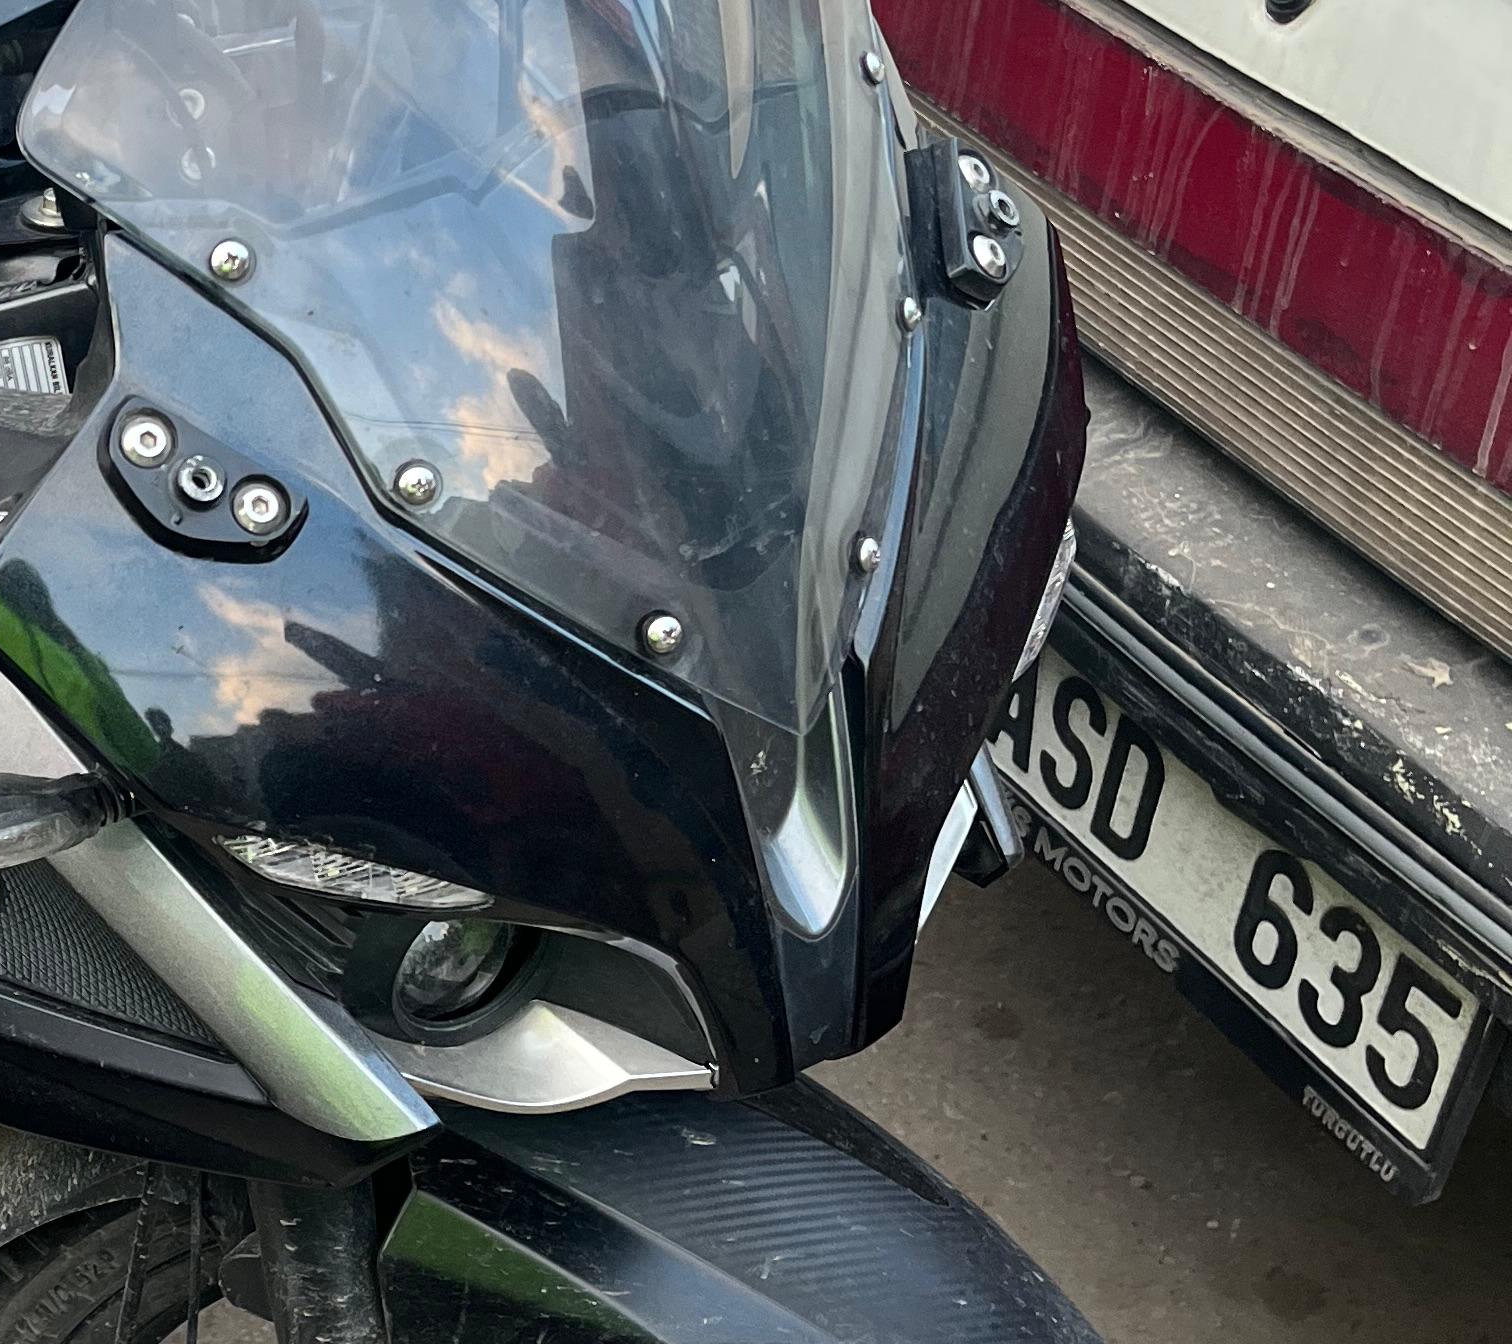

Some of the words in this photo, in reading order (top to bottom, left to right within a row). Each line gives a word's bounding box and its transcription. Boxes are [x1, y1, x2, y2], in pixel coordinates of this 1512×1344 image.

[988, 660, 1166, 861] ASD
[1233, 848, 1464, 1111] 635
[1033, 830, 1180, 974] MOTORS
[1302, 1086, 1399, 1183] TURGUTLU
